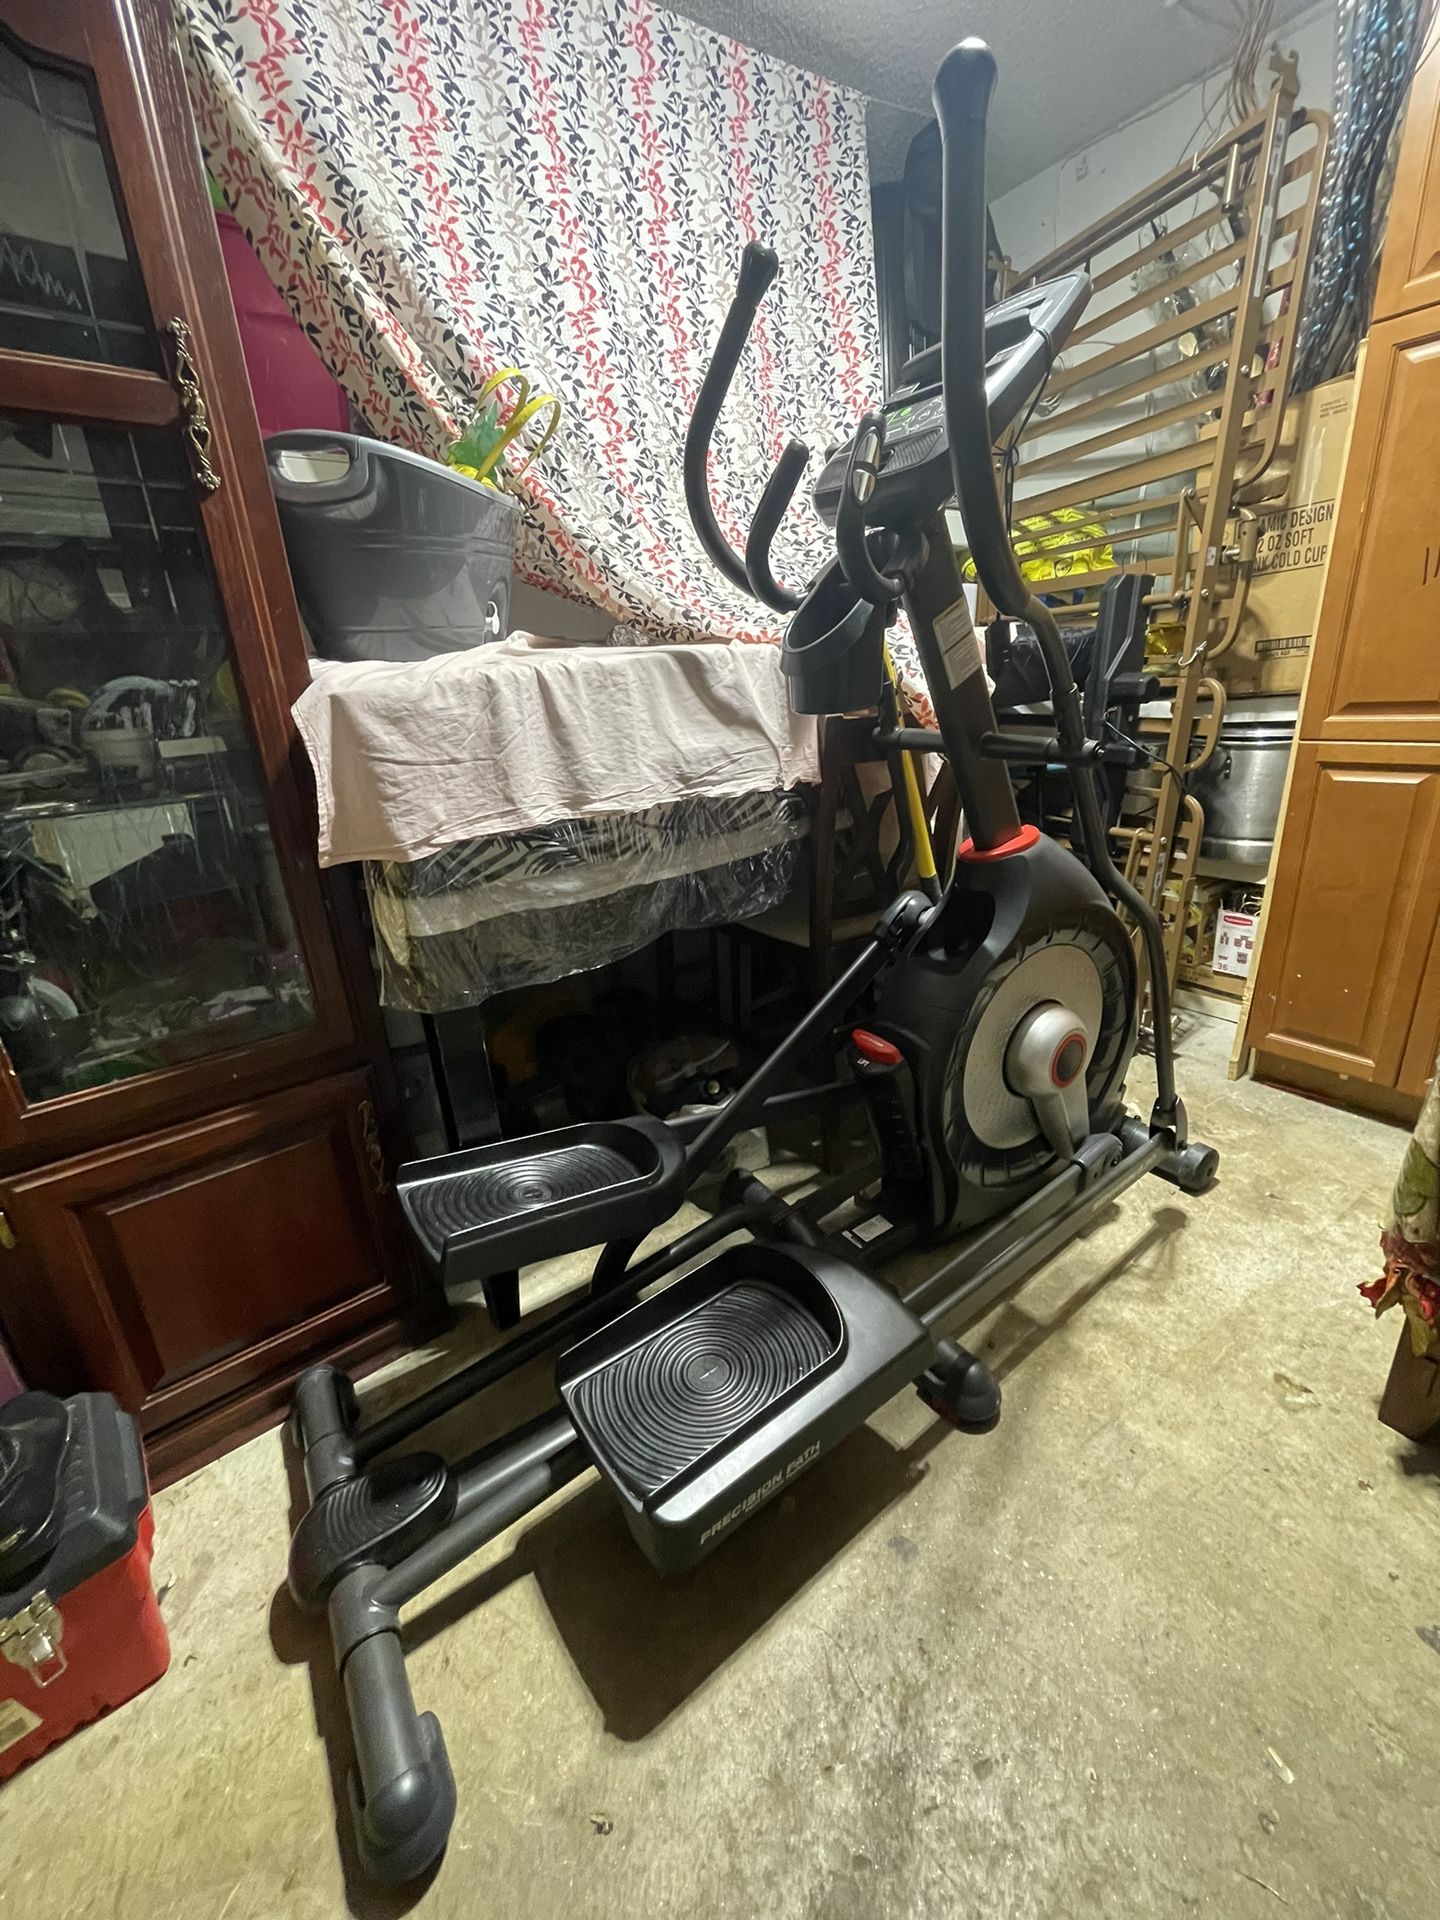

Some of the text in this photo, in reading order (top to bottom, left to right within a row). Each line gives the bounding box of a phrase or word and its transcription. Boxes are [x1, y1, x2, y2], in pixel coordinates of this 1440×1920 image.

[1290, 503, 1335, 529] DESIGN
[1267, 534, 1282, 552] OZ
[1284, 526, 1315, 549] SOFT
[1271, 549, 1301, 569] COLD
[1217, 962, 1228, 970] 36
[700, 1440, 820, 1545] PRECISION PATH
